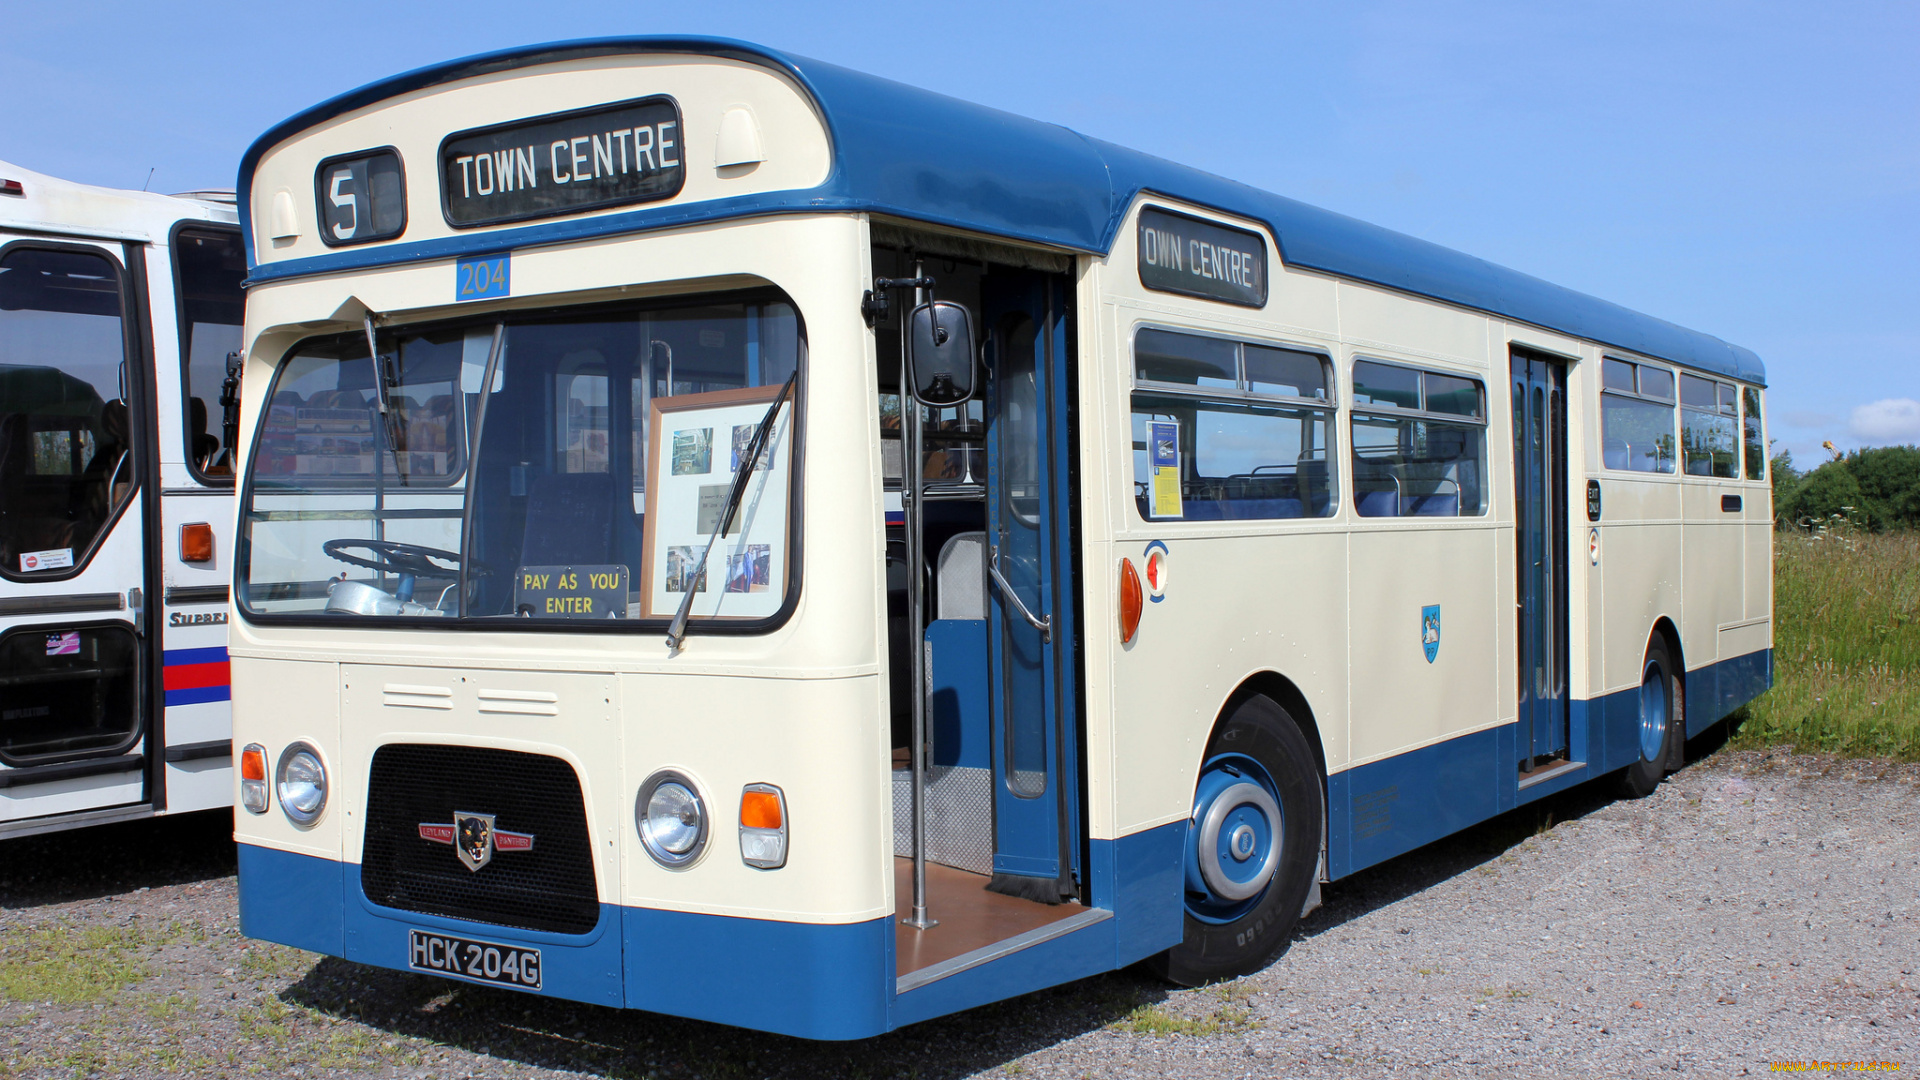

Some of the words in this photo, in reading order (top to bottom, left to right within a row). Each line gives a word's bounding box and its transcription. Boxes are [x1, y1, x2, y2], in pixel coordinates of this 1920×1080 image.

[456, 146, 537, 198] TOWN
[550, 121, 680, 184] CENTRE
[329, 170, 358, 240] 5
[1141, 226, 1183, 272] OWN
[1189, 239, 1252, 288] CENTRE
[461, 260, 506, 295] 204
[1589, 488, 1599, 498] EXIT
[989, 485, 999, 532] OPEN
[1589, 502, 1599, 513] ONLY
[524, 574, 550, 590] PAY
[558, 573, 578, 590] AS
[589, 573, 619, 589] YOU
[546, 597, 593, 613] ENTER
[422, 827, 451, 838] LEYLAND
[499, 836, 529, 847] PANTHER
[412, 934, 461, 972] HCK
[466, 944, 538, 984] 204G
